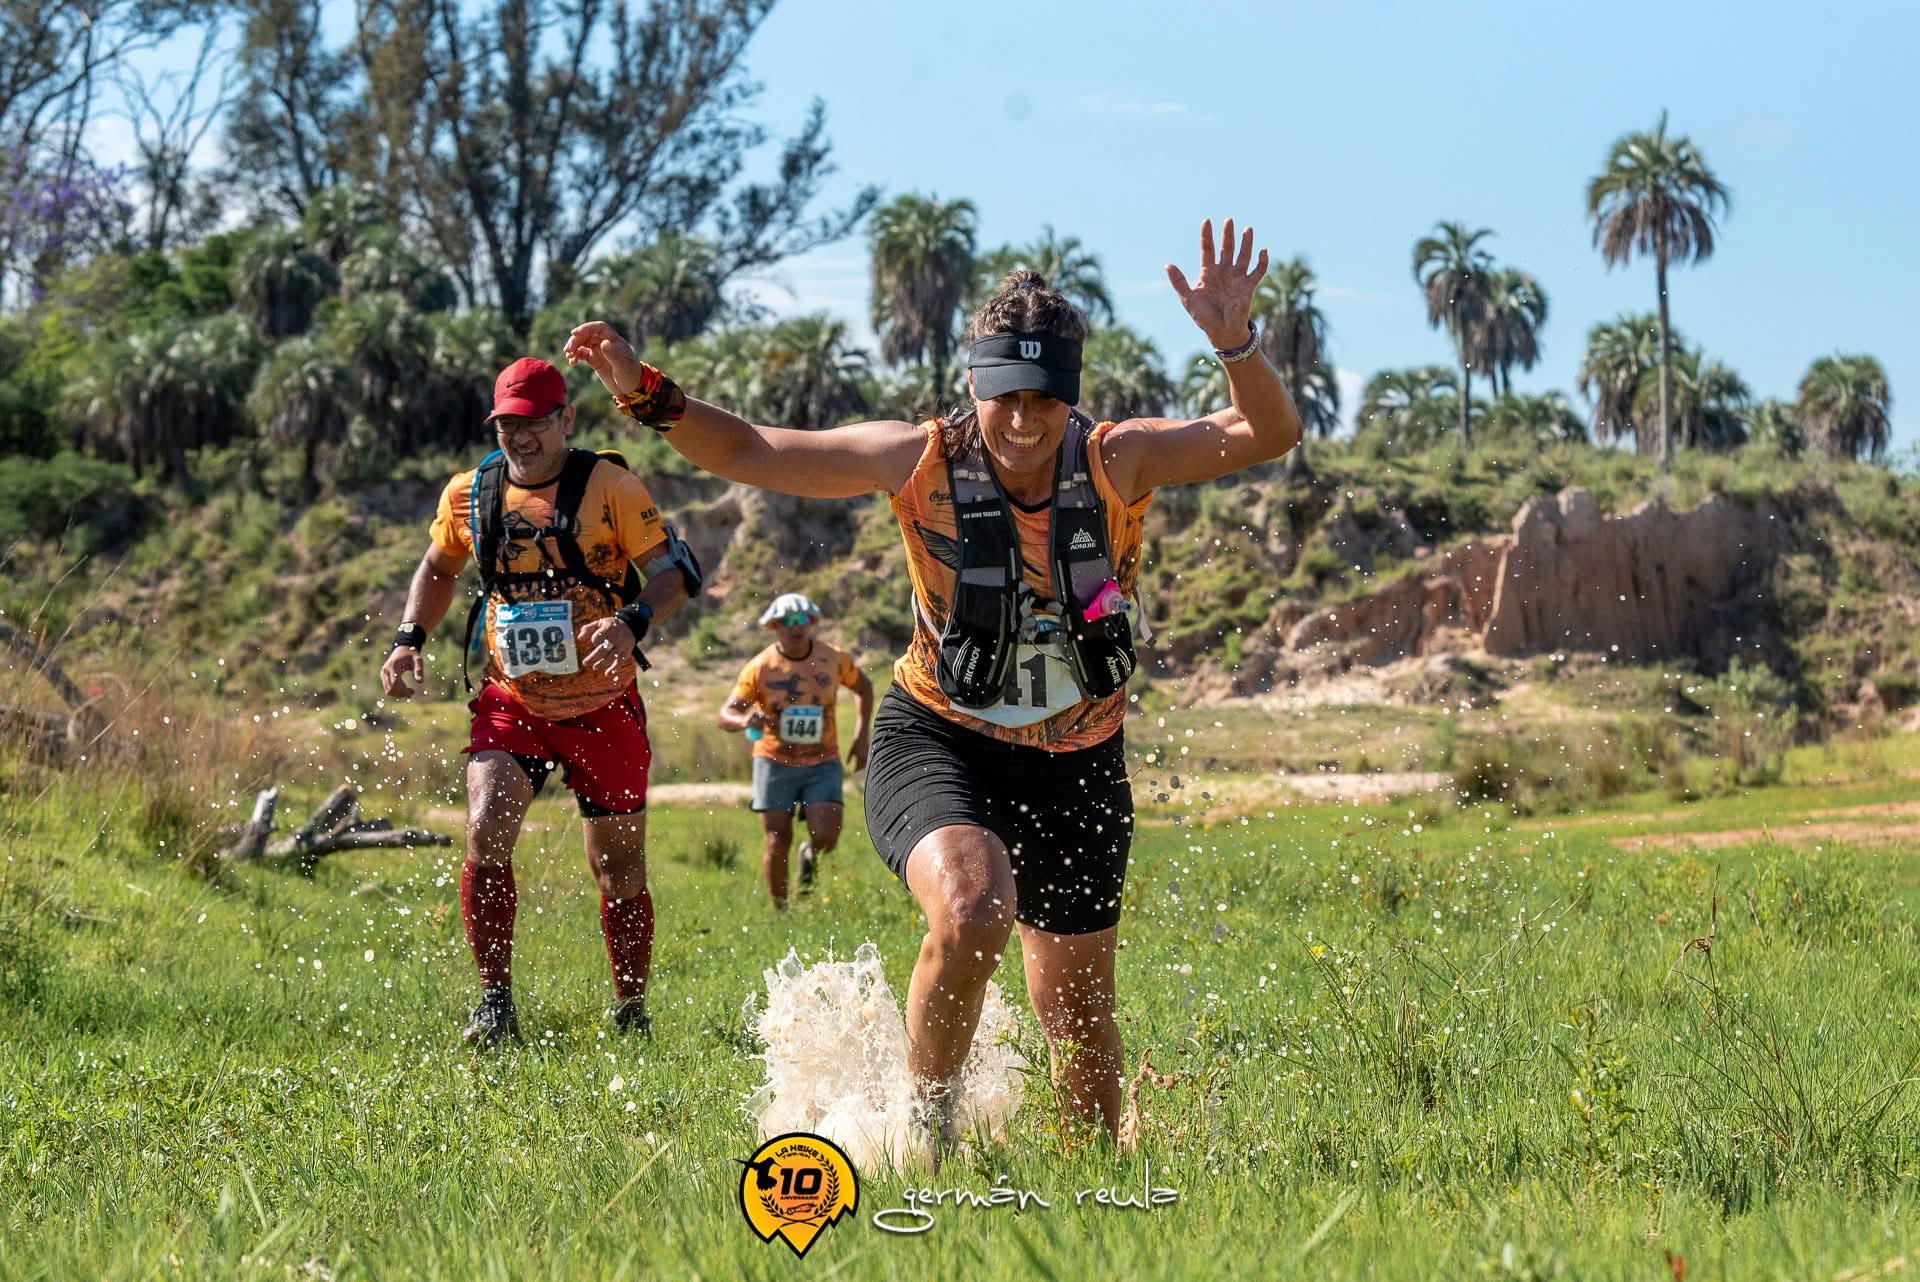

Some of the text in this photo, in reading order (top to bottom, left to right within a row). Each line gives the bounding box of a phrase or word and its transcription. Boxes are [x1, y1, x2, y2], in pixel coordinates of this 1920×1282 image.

[1070, 542, 1097, 550] AONIJIE
[506, 626, 567, 666] 138
[963, 645, 981, 685] AONIJIE
[786, 719, 817, 738] 144
